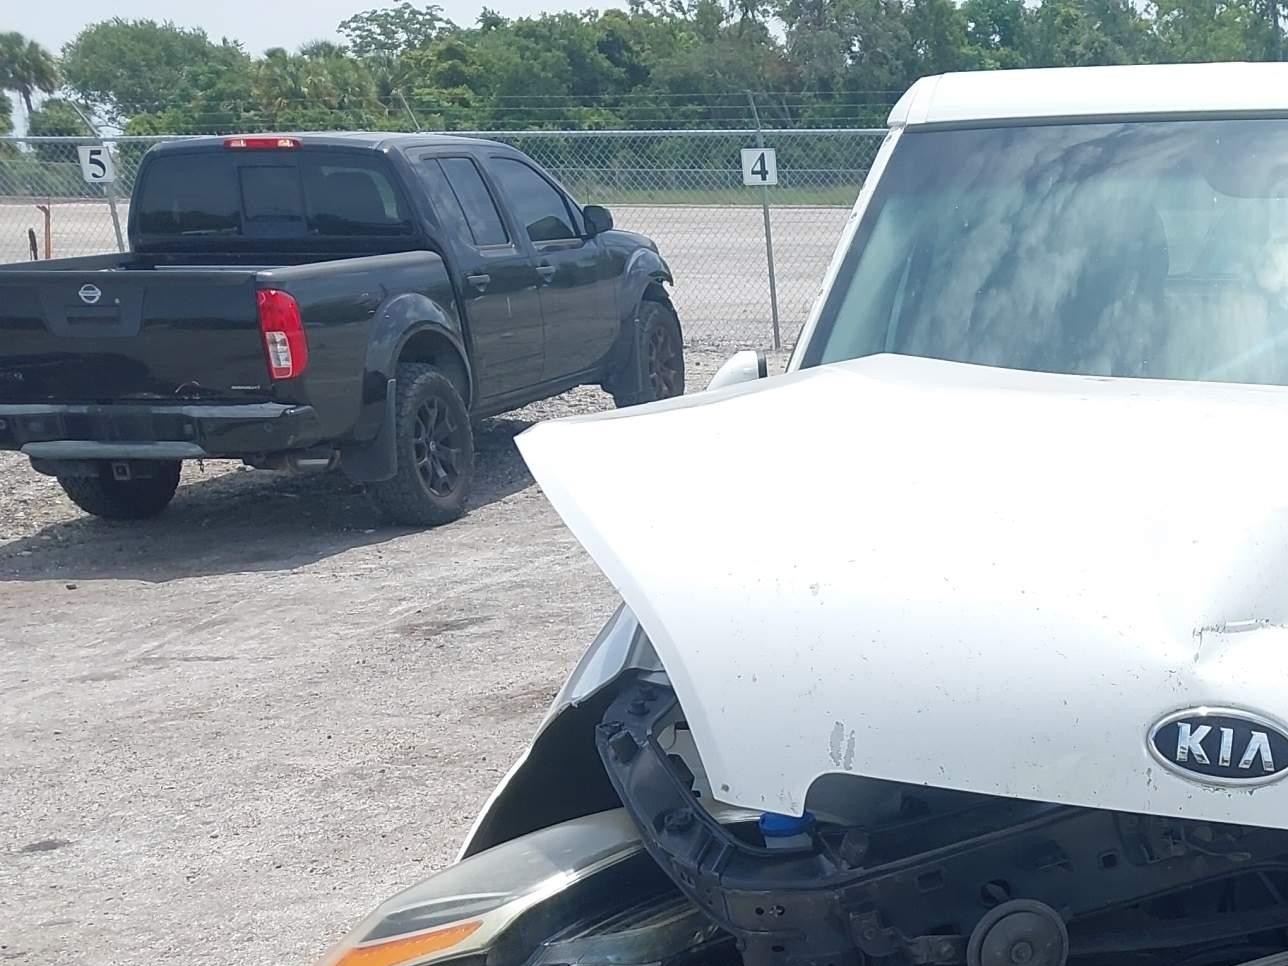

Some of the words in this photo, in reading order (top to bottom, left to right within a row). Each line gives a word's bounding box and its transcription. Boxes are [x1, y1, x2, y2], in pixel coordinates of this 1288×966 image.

[90, 149, 106, 179] 5
[751, 151, 769, 181] 4
[1176, 721, 1275, 772] KIA
